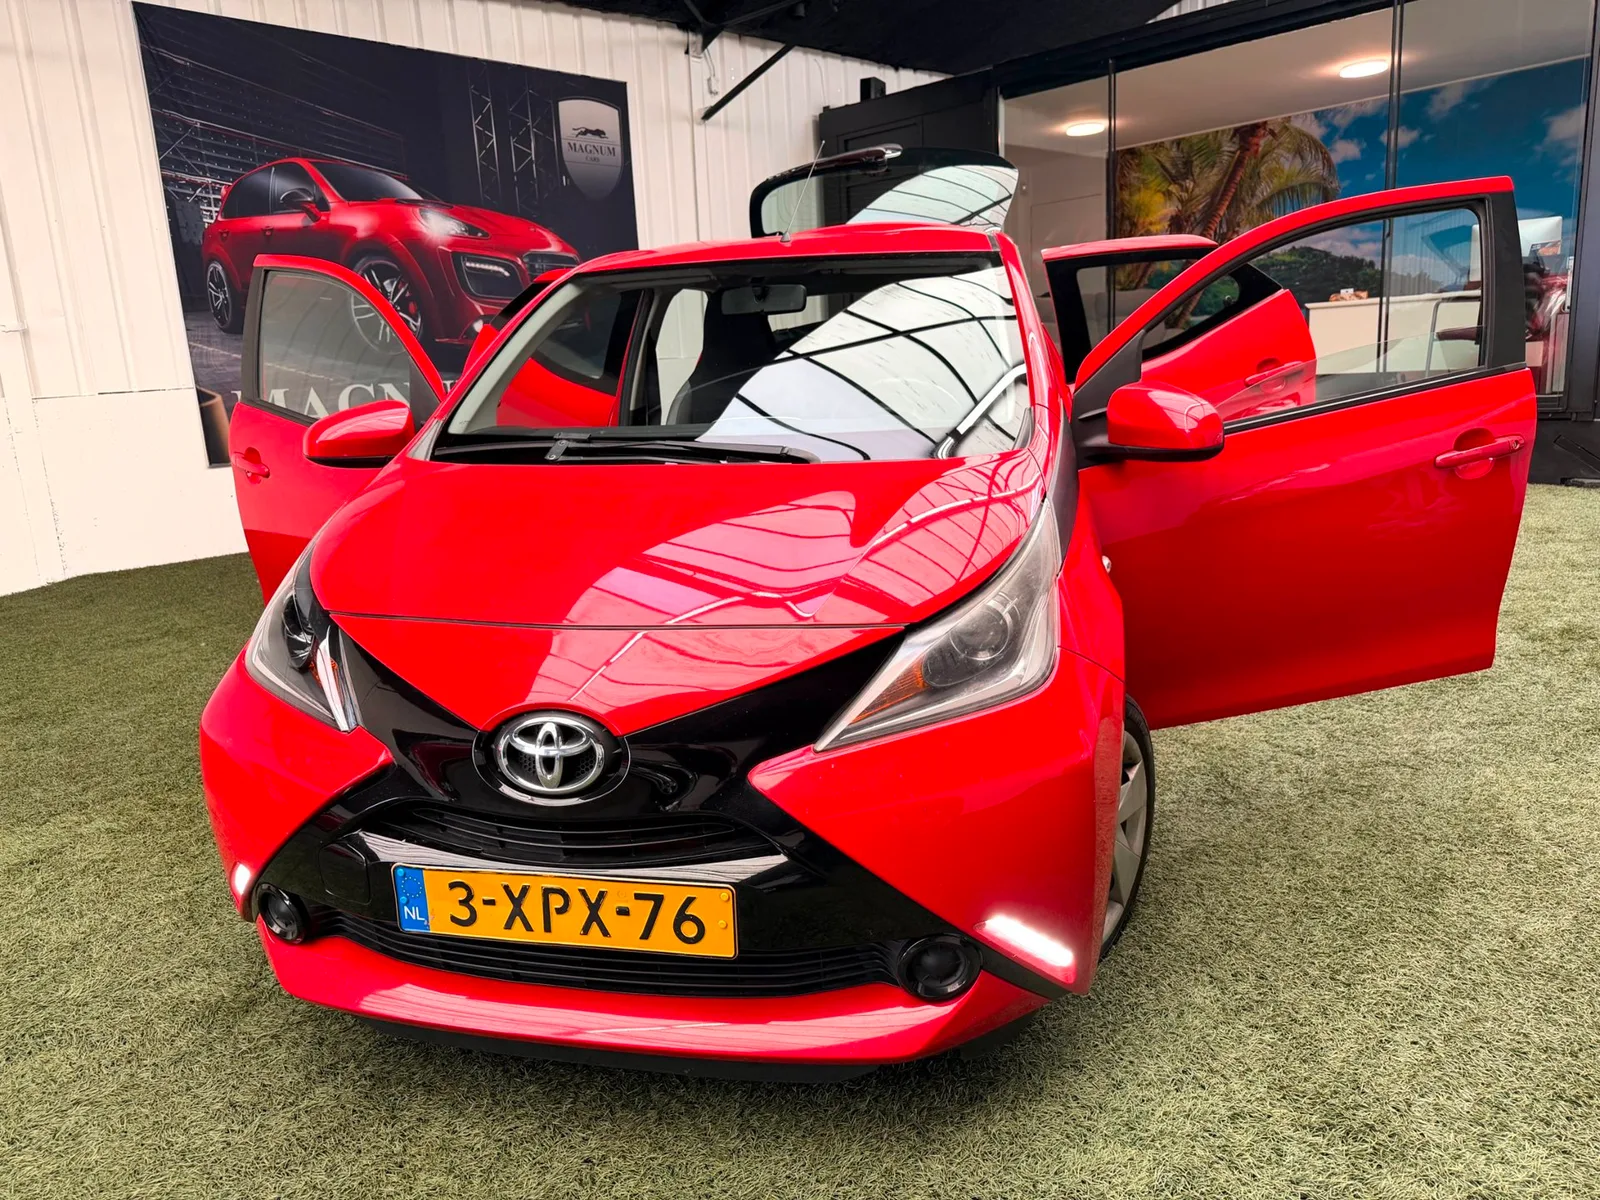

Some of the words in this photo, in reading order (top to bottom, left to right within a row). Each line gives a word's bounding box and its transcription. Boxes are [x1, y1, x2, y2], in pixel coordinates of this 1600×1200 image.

[567, 141, 616, 157] MAGNUM
[403, 905, 426, 921] NL
[448, 880, 706, 945] 3-XPX-76
